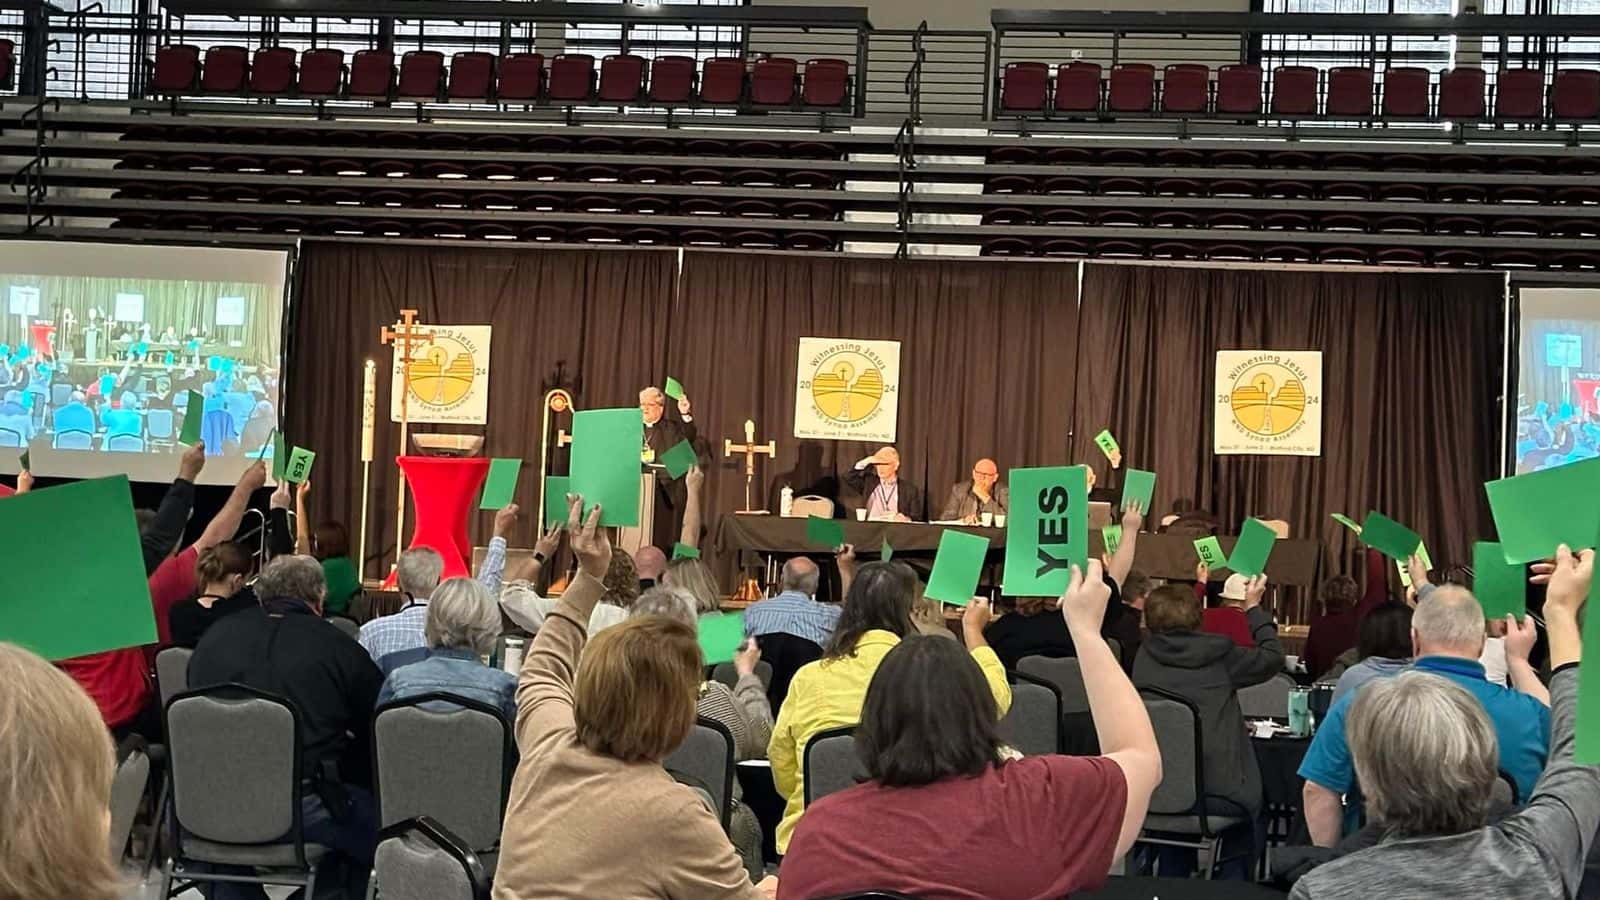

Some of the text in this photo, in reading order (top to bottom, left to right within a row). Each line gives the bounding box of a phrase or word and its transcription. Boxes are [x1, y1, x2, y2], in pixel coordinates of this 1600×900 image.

[809, 343, 887, 370] Witnessing Jesus
[475, 367, 486, 376] 24
[1227, 353, 1308, 381] Witnessing Jesus
[800, 380, 811, 389] 20
[884, 385, 896, 393] 24
[1217, 394, 1230, 404] 20
[1307, 396, 1319, 405] 24
[293, 455, 308, 479] YES
[1035, 485, 1069, 579] YES
[1199, 545, 1215, 567] YES
